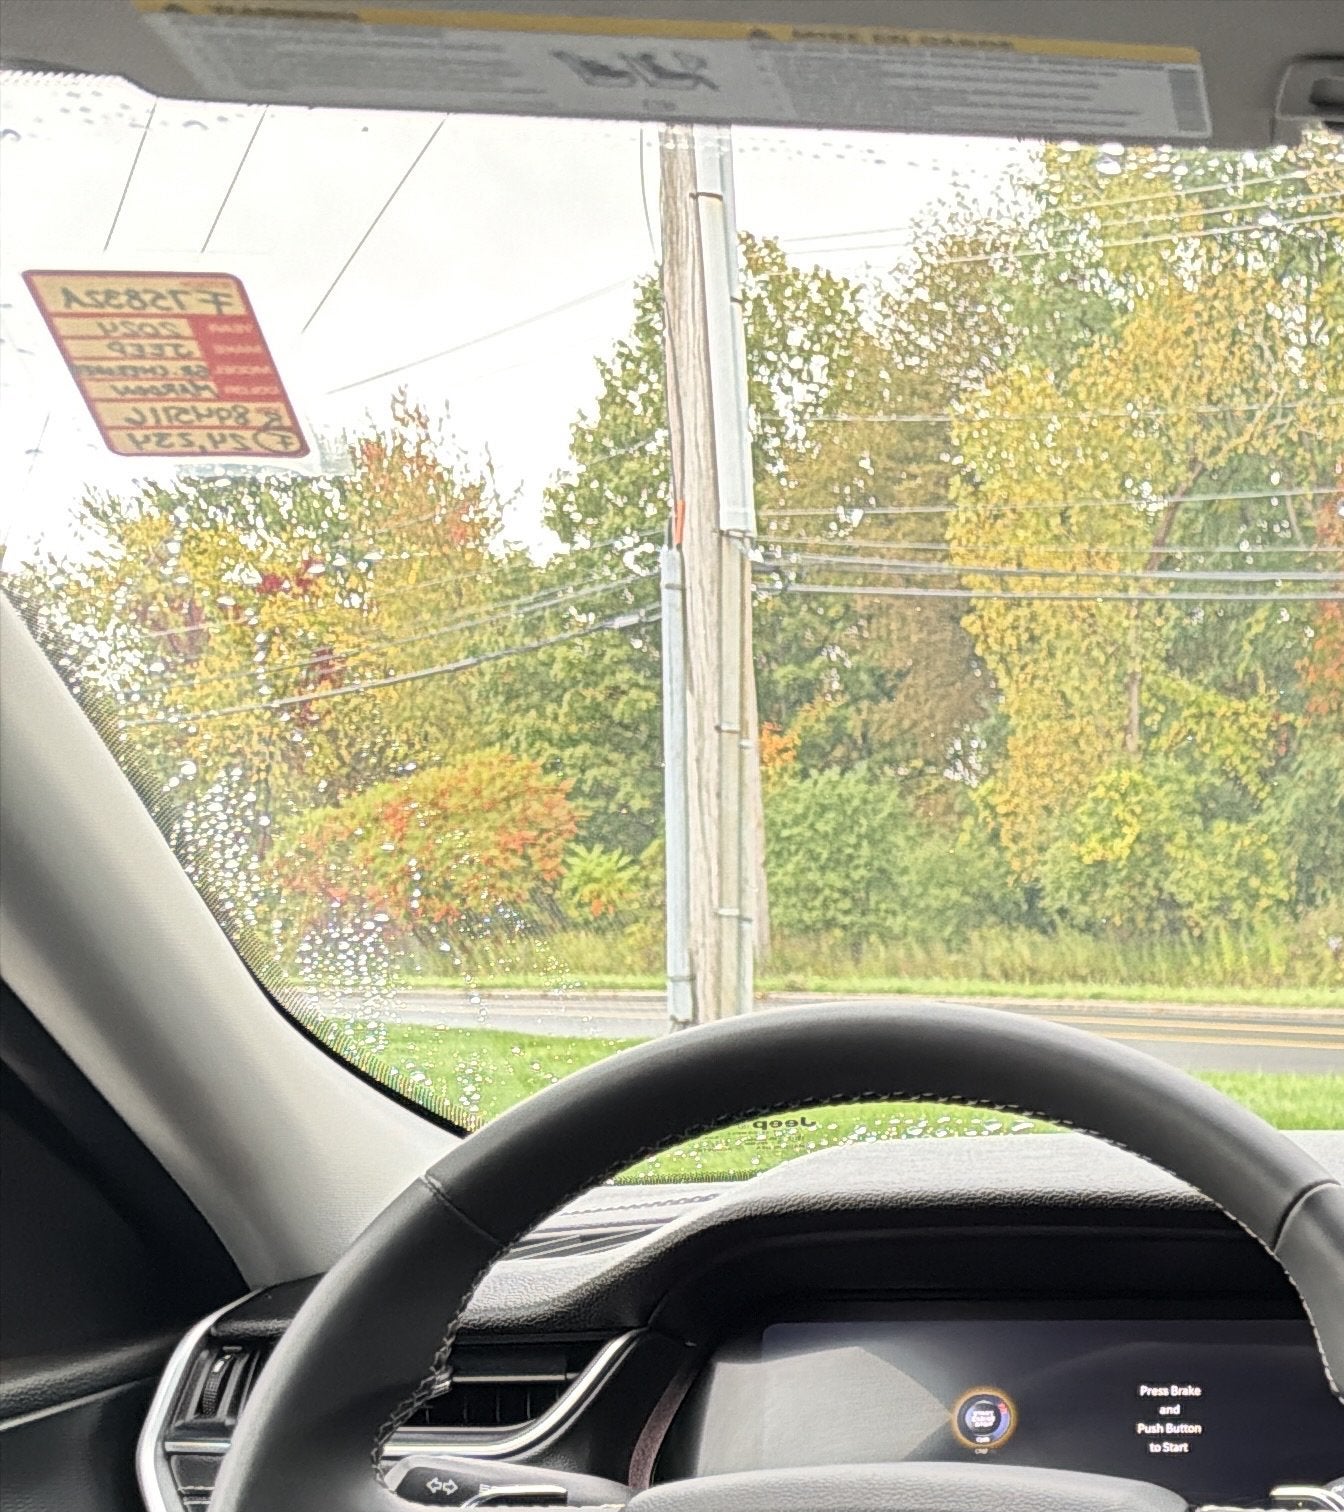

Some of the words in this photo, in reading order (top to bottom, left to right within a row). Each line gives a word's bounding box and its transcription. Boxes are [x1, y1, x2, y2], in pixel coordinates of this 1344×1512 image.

[1140, 1385, 1169, 1396] Press
[1170, 1385, 1202, 1396] Brake
[1159, 1404, 1181, 1415] and
[1137, 1423, 1164, 1434] Push
[1165, 1423, 1202, 1434] Button
[1149, 1443, 1161, 1453] to
[1162, 1441, 1189, 1453] Start
